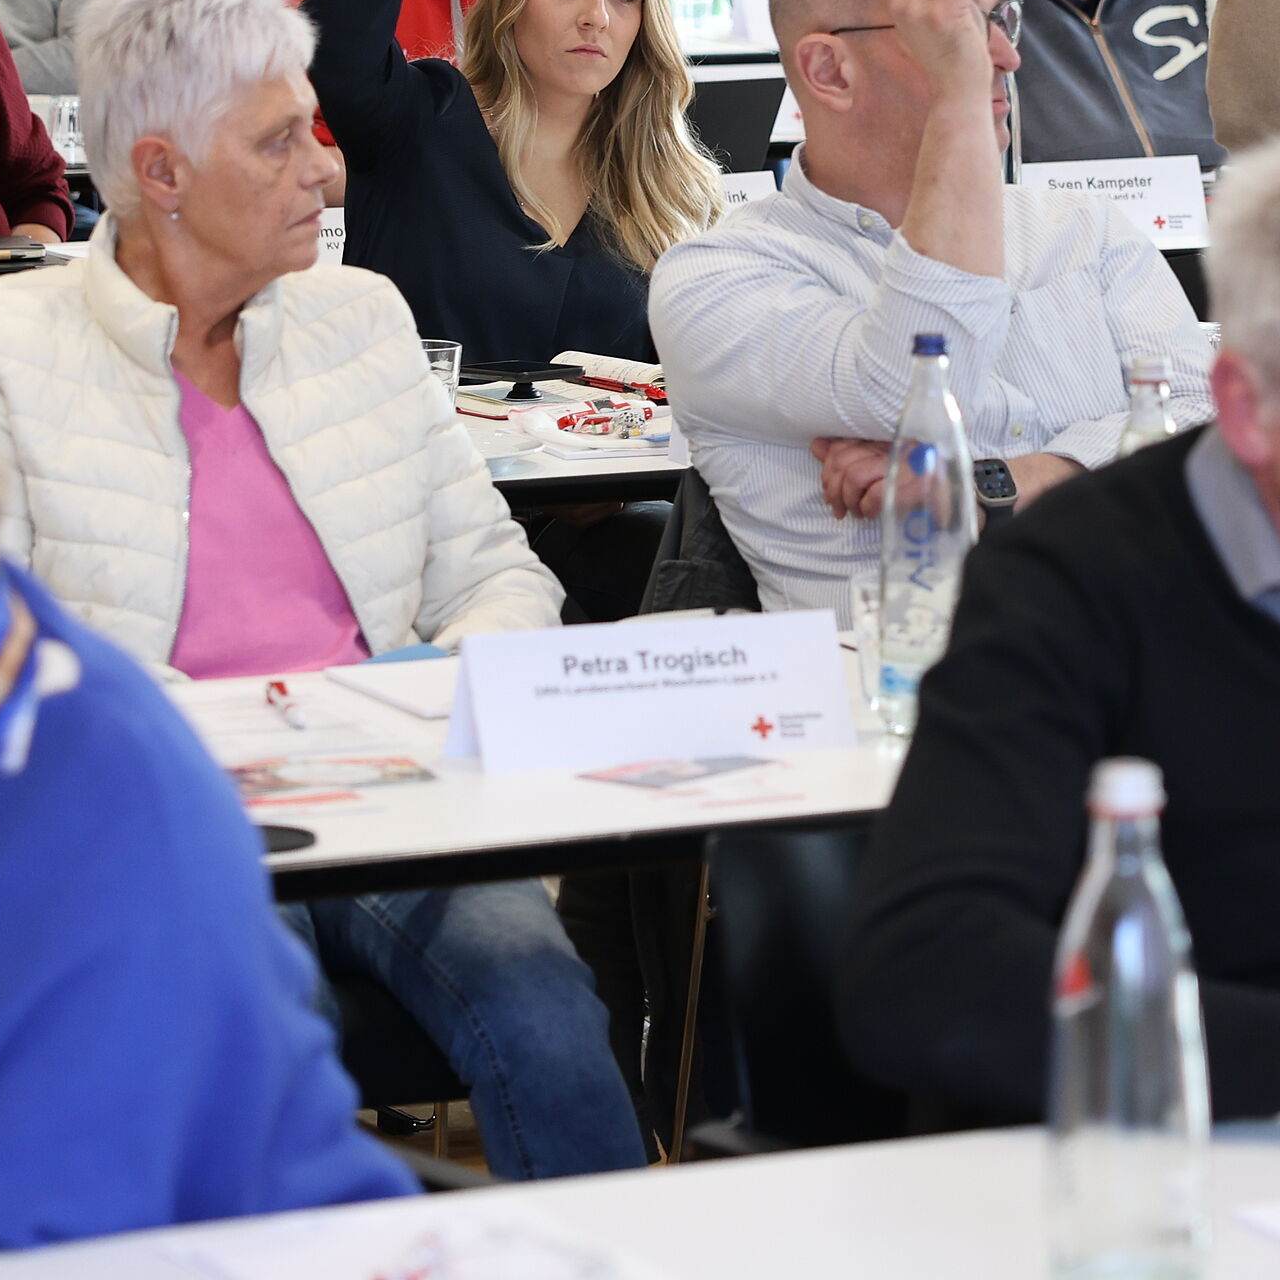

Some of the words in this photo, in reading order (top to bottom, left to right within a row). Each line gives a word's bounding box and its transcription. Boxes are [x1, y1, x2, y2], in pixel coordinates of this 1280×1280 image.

[1048, 178, 1082, 190] Sven
[1087, 176, 1152, 191] Kampeter
[326, 241, 339, 249] KV
[562, 654, 628, 675] Petra
[635, 646, 747, 674] Trogisch
